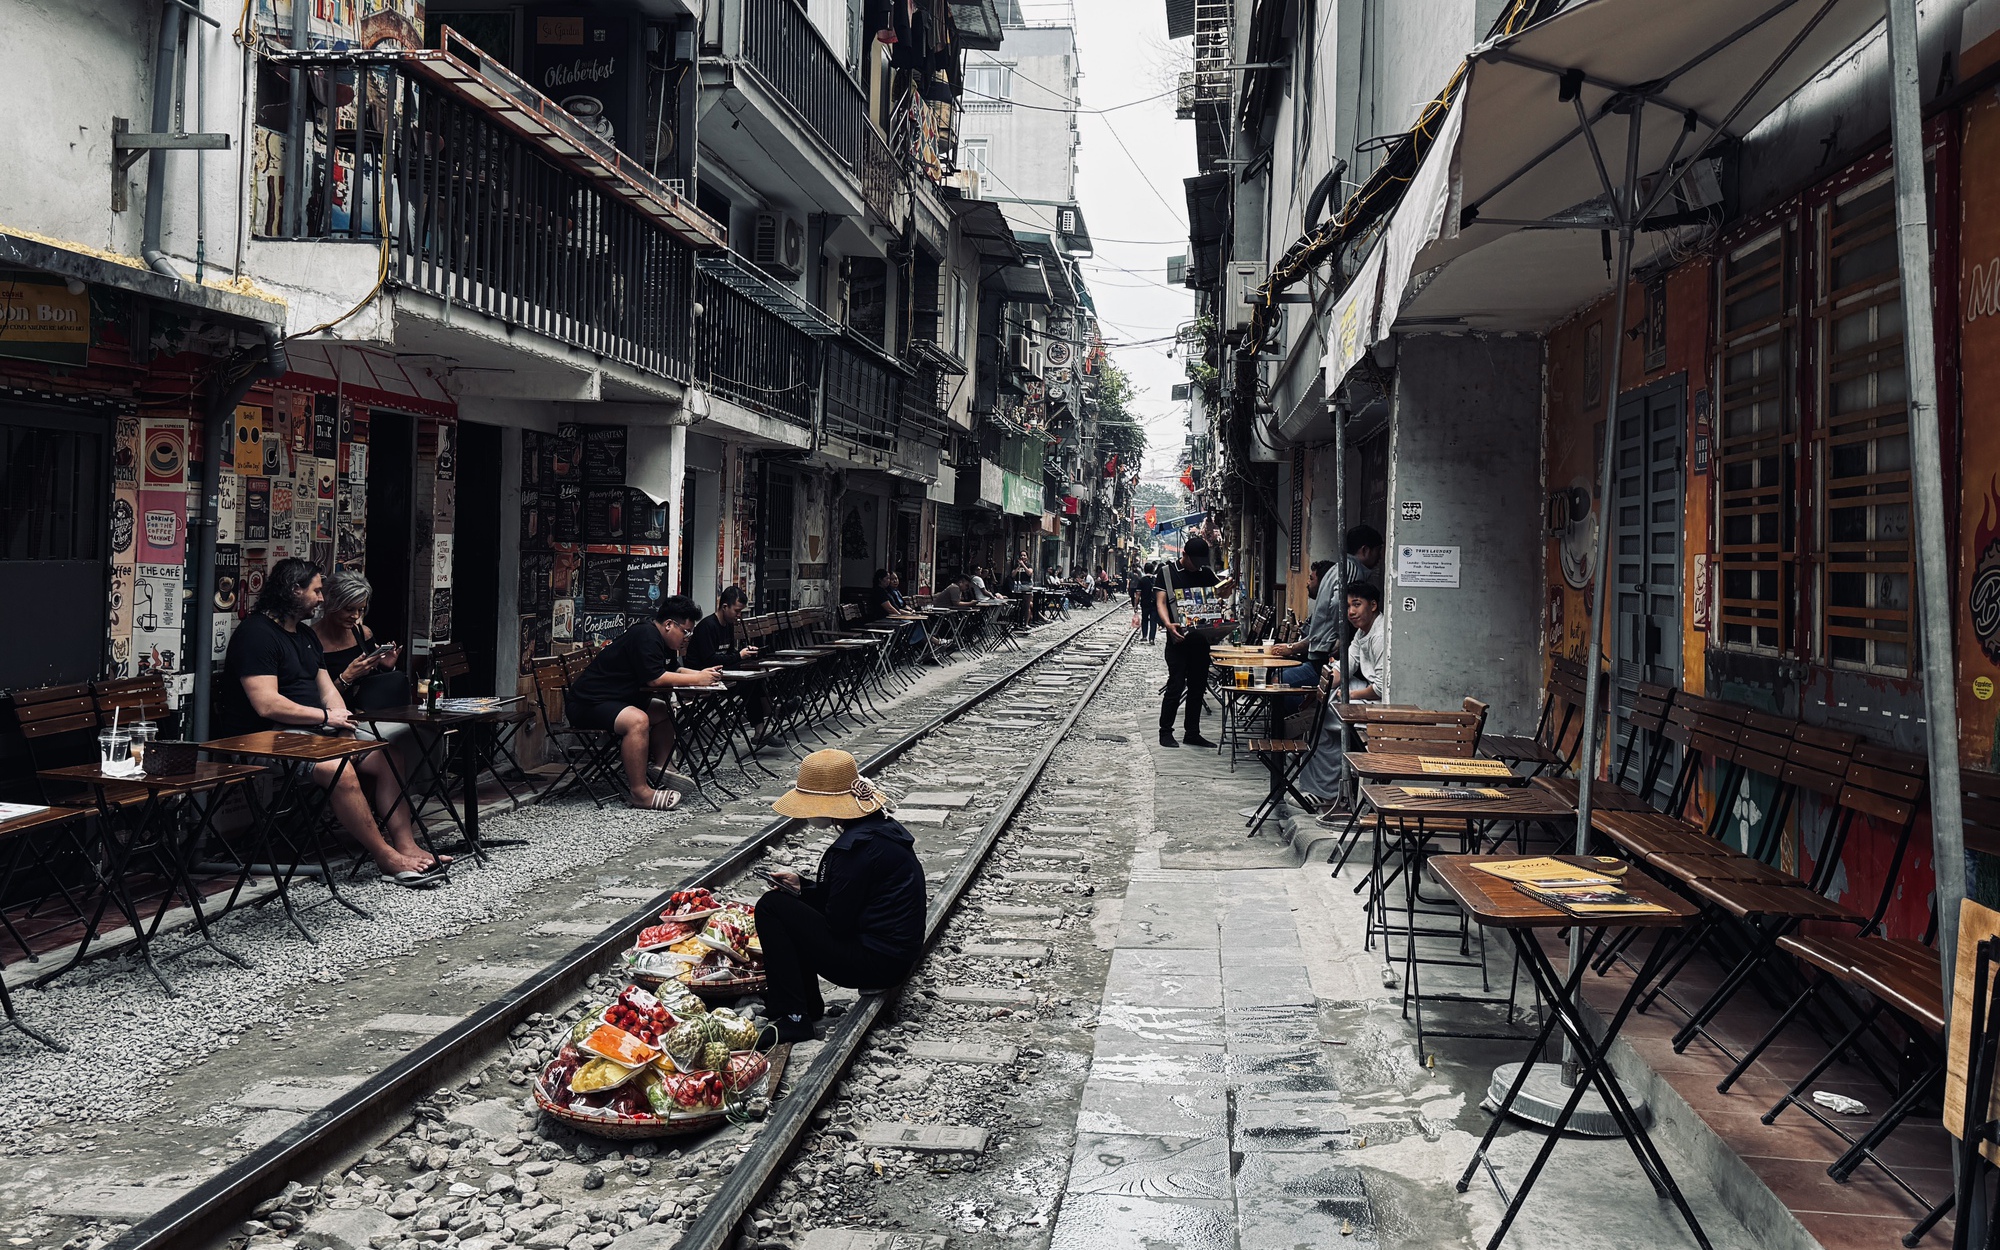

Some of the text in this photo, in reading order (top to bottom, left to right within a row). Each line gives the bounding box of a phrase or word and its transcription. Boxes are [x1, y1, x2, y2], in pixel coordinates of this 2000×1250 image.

[544, 56, 615, 88] Oktoberfest
[0, 304, 77, 322] on Bon
[587, 430, 624, 441] MANHATTAN
[273, 489, 292, 500] GOOD
[222, 498, 236, 509] CLUB
[272, 526, 292, 539] COFFEE
[215, 552, 238, 565] COFFEE
[588, 558, 621, 568] QUARANTINE
[138, 566, 180, 577] THE CAFÉ
[641, 561, 667, 570] Hawaiian
[111, 566, 132, 578] offee
[584, 614, 624, 633] Cocktails
[1569, 631, 1588, 664] coffe
